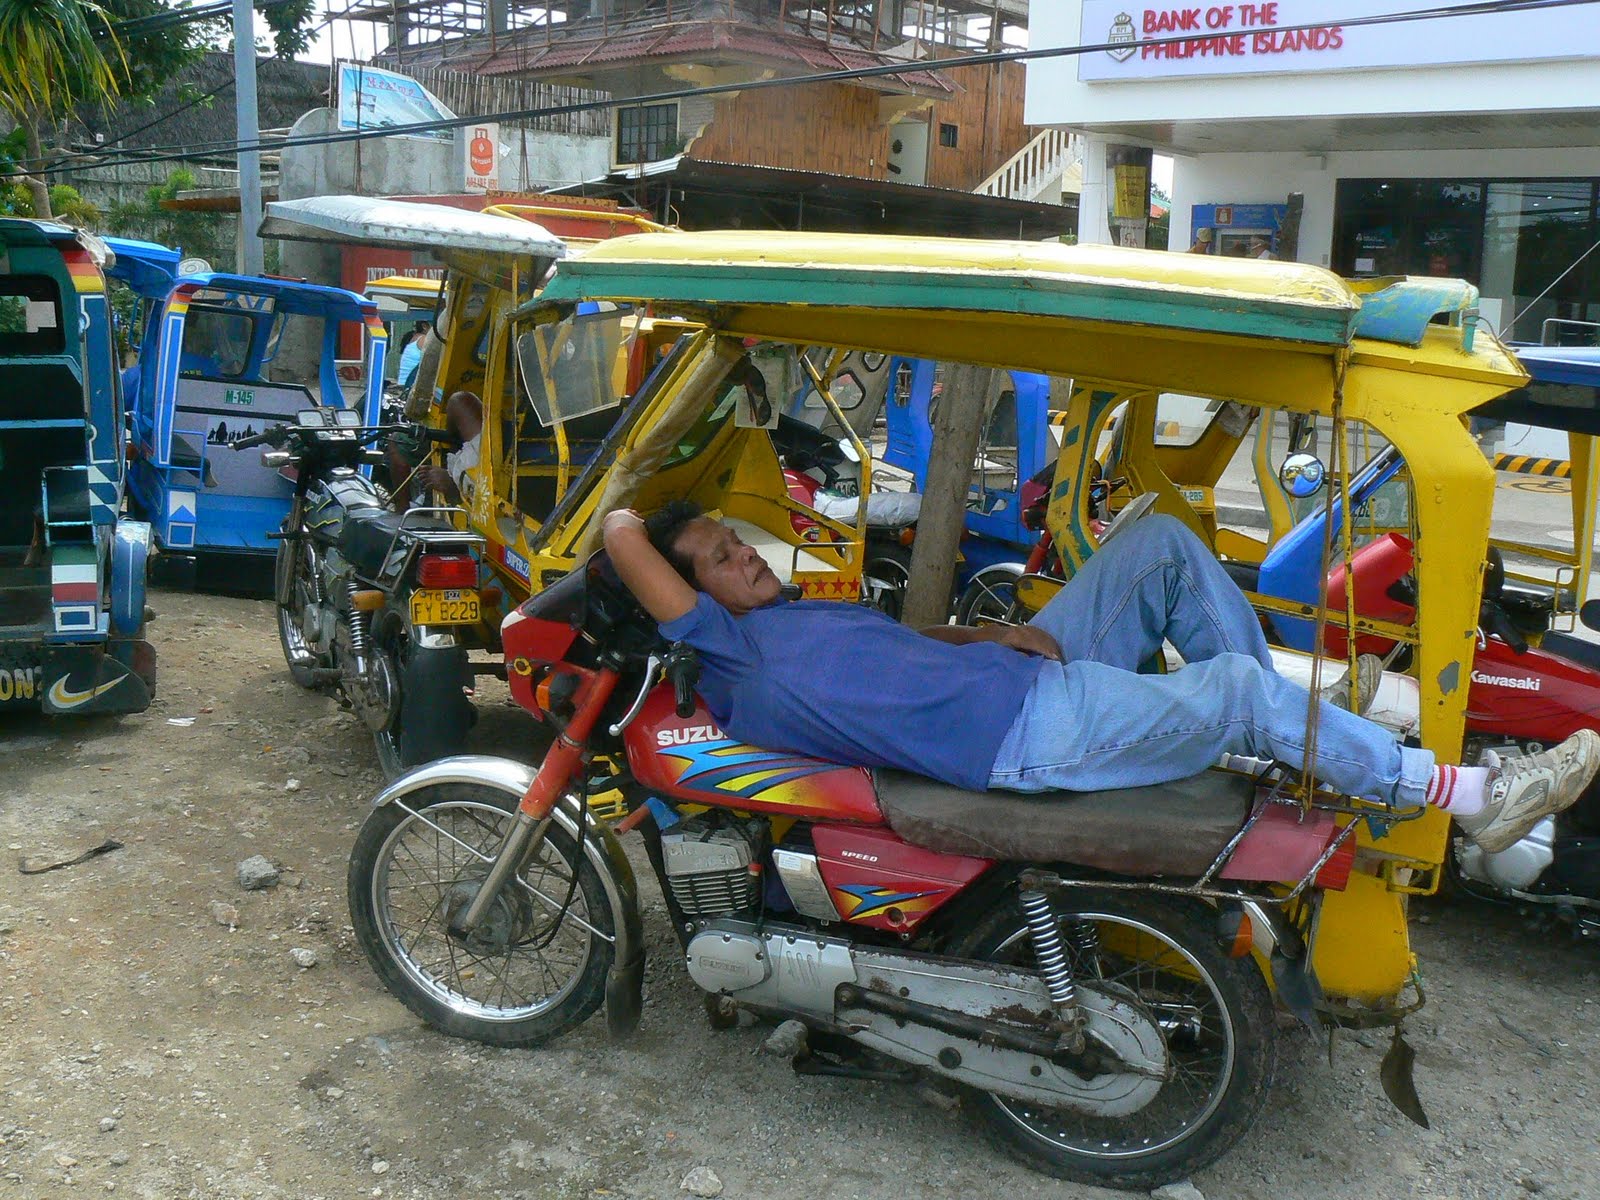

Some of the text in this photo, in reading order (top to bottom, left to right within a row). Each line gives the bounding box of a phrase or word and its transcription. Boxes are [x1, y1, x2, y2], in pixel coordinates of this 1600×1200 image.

[1142, 2, 1278, 33] BANK OF THE
[1141, 26, 1343, 60] PHILIPPINE ISLANDS
[225, 390, 253, 404] M-145
[1470, 670, 1541, 691] Kawasaki
[656, 725, 729, 746] SUZU
[841, 850, 878, 862] SPEED
